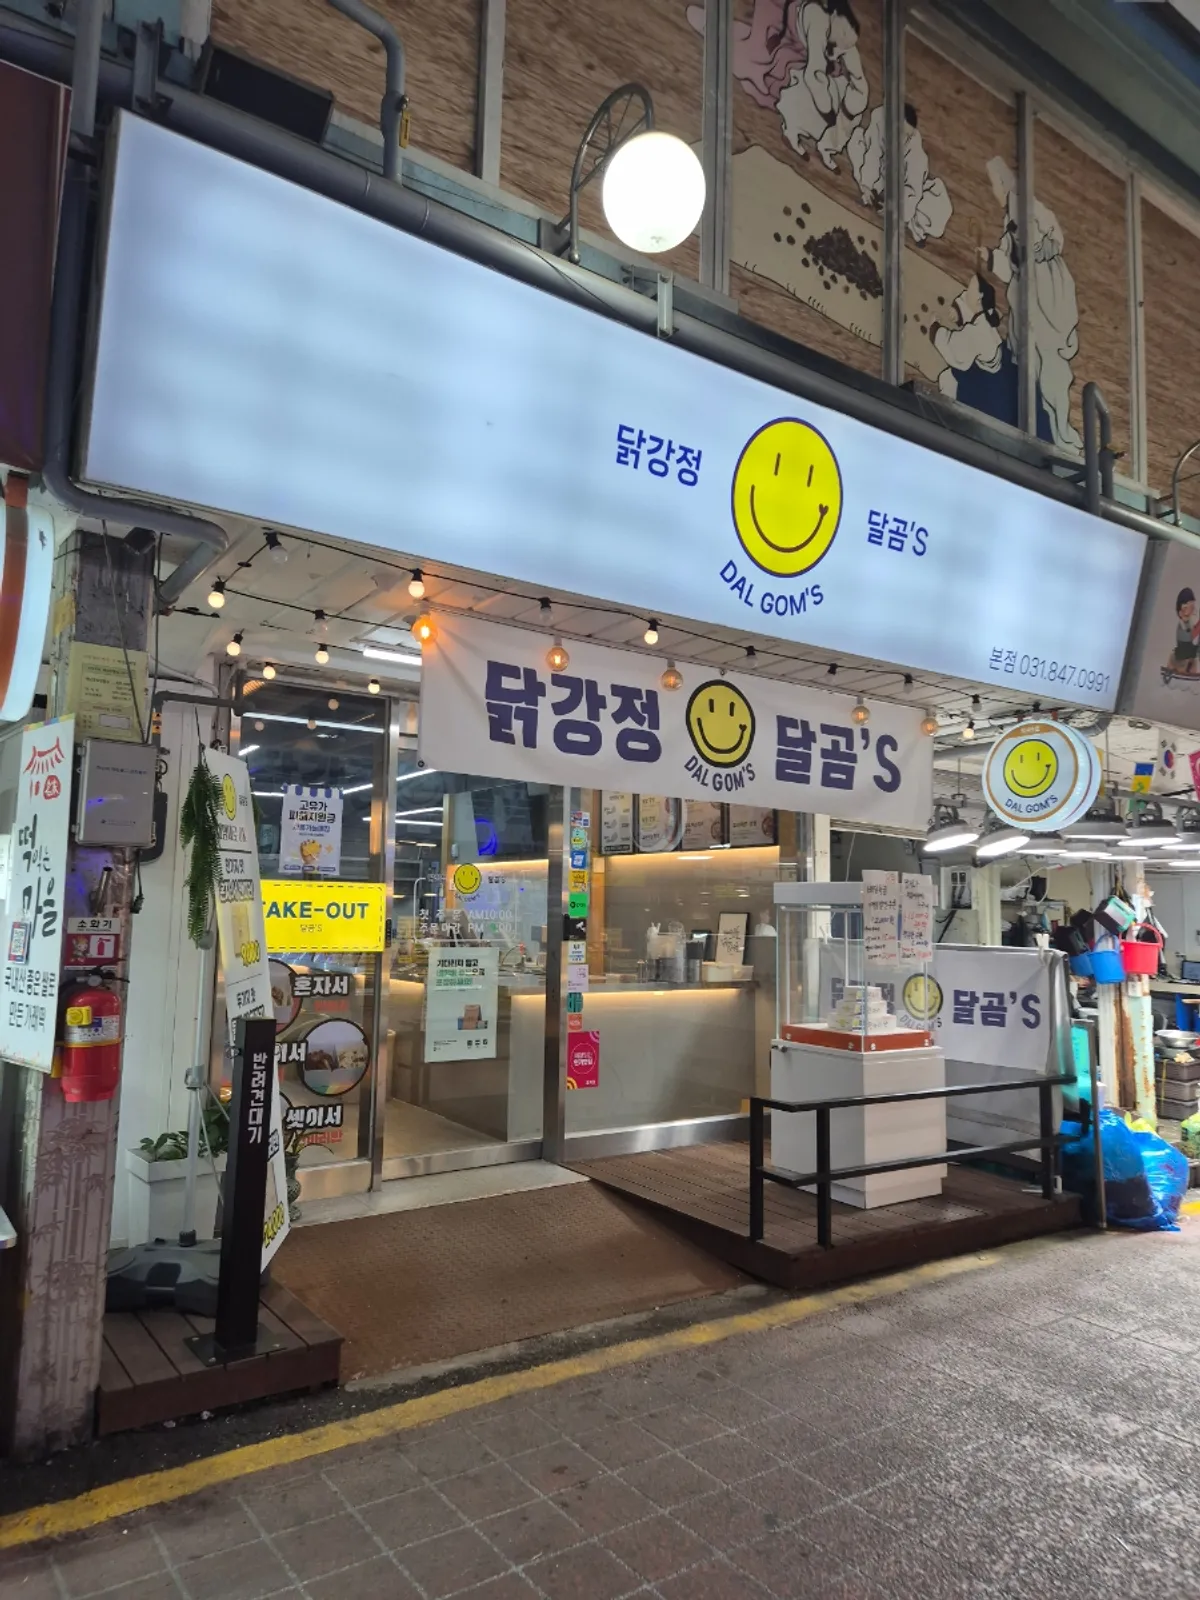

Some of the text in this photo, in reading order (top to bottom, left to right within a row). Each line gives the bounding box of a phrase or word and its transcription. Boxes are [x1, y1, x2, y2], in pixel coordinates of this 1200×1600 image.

[615, 423, 702, 487] 닭강정
[867, 509, 928, 556] 달곰'S
[719, 560, 825, 616] DAL GOM'S
[989, 645, 1111, 694] 본점 031.847.0991
[485, 660, 662, 763] 닭강정
[684, 755, 756, 793] DAL GOM'S
[775, 714, 902, 793] 달곰'S
[300, 800, 328, 812] 고유가
[1005, 794, 1059, 813] DAL GOM'S
[262, 901, 370, 919] AKE-OUT
[294, 975, 349, 996] 혼자서
[952, 988, 1041, 1030] 달곰'S
[275, 1042, 307, 1063] 이서
[248, 1052, 267, 1144] 반려견대기
[286, 1105, 342, 1128] 셋이서
